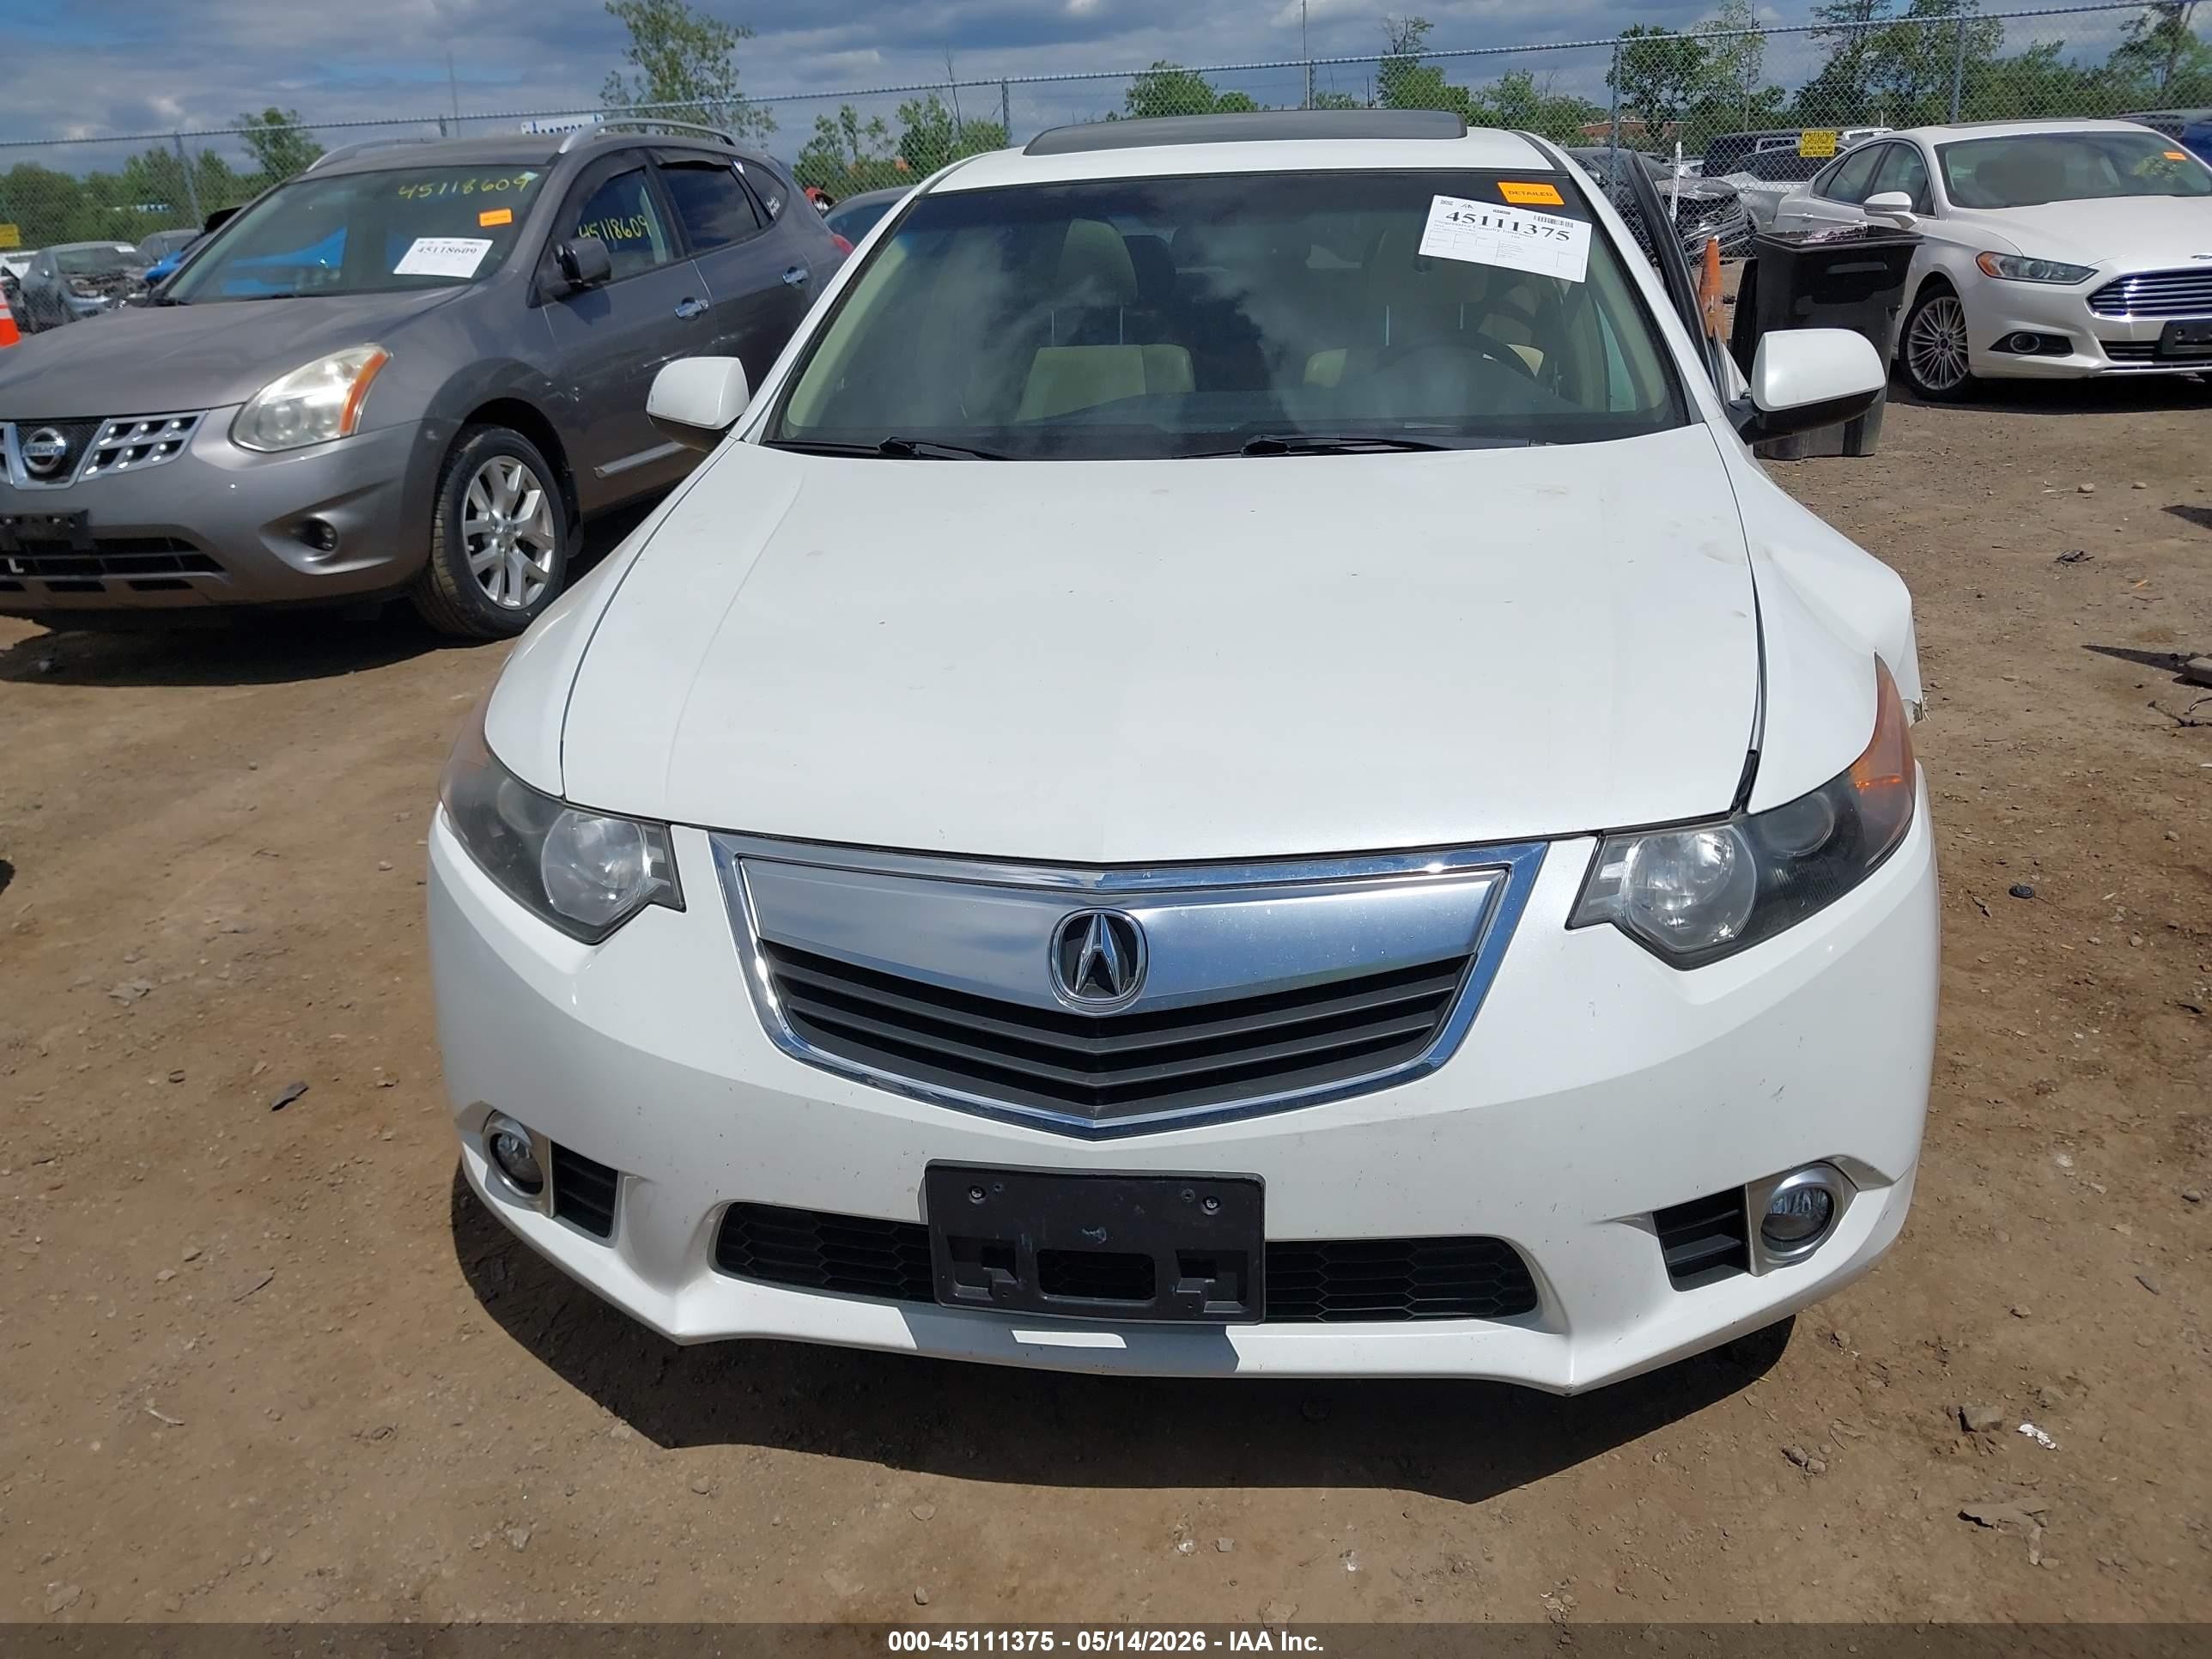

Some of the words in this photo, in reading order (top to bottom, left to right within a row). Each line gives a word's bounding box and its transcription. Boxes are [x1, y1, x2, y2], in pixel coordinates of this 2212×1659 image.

[398, 177, 530, 199] 45118609
[577, 215, 652, 240] 45118609
[1445, 211, 1571, 242] 45111375
[416, 245, 478, 255] 45118609
